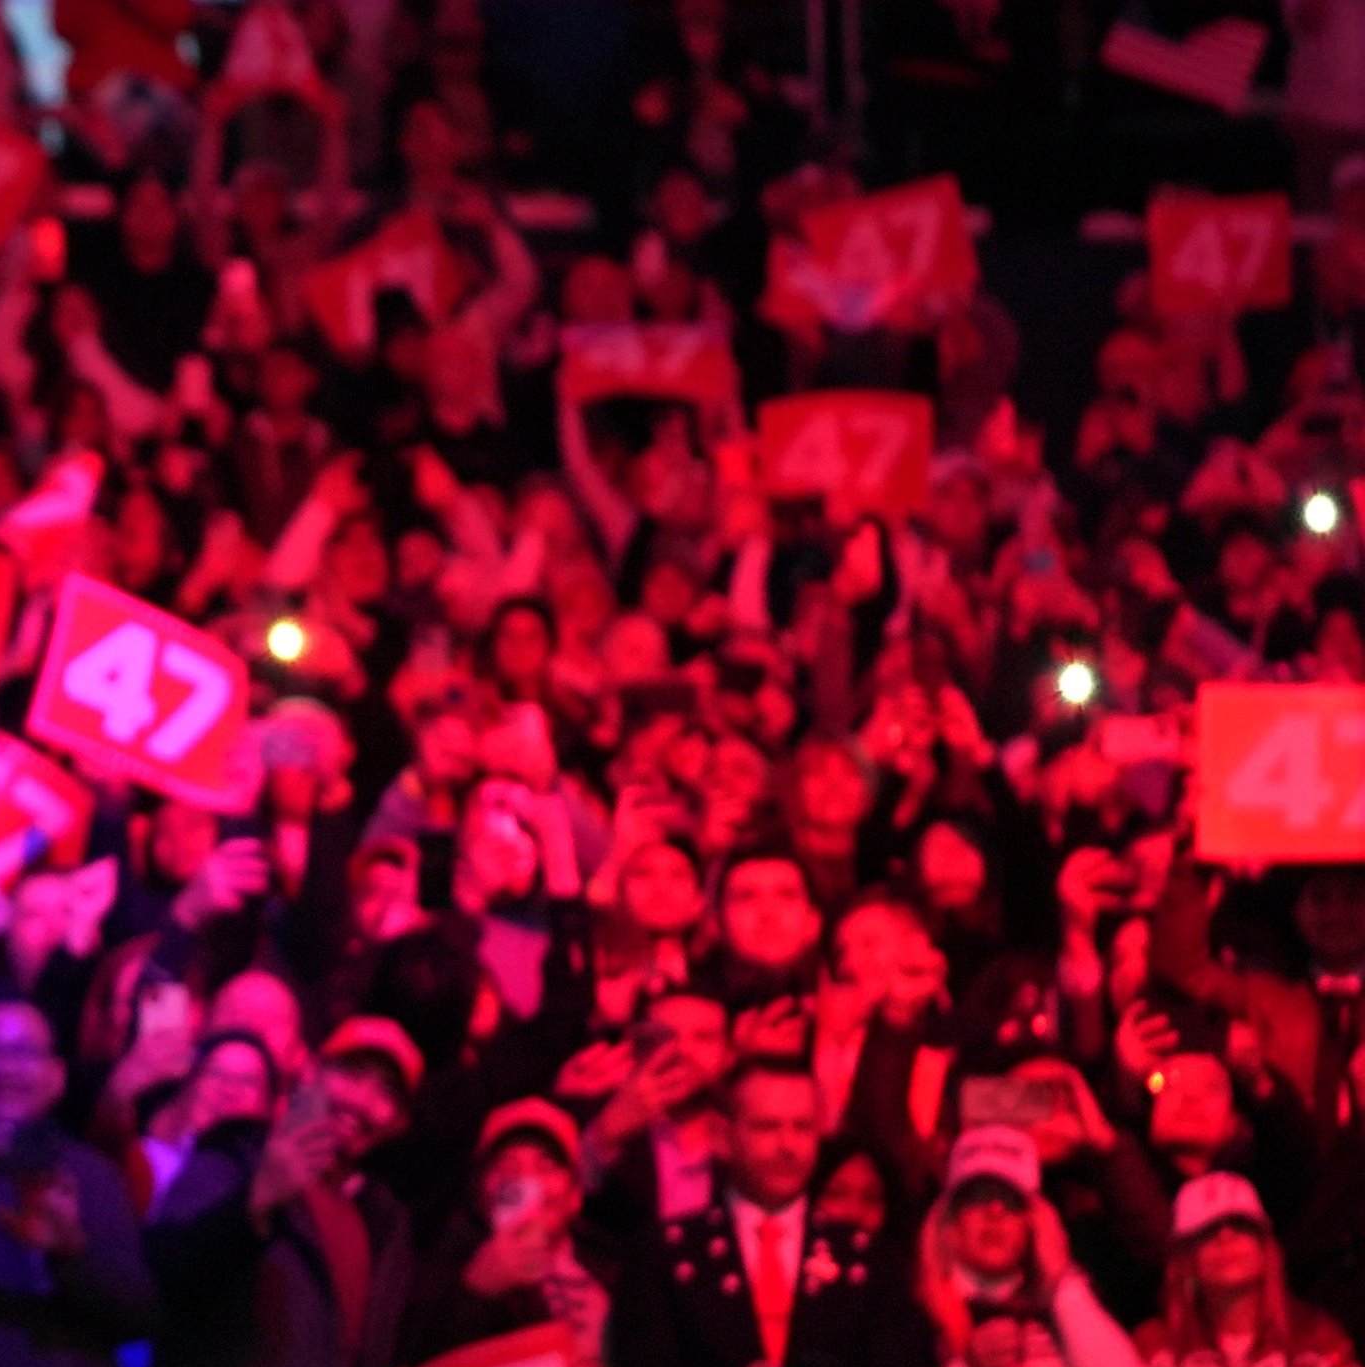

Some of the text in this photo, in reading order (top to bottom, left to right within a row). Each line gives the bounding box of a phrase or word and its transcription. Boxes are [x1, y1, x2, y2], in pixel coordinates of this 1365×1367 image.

[1171, 211, 1272, 290] 47
[778, 410, 909, 492] 47
[62, 620, 231, 763] 47
